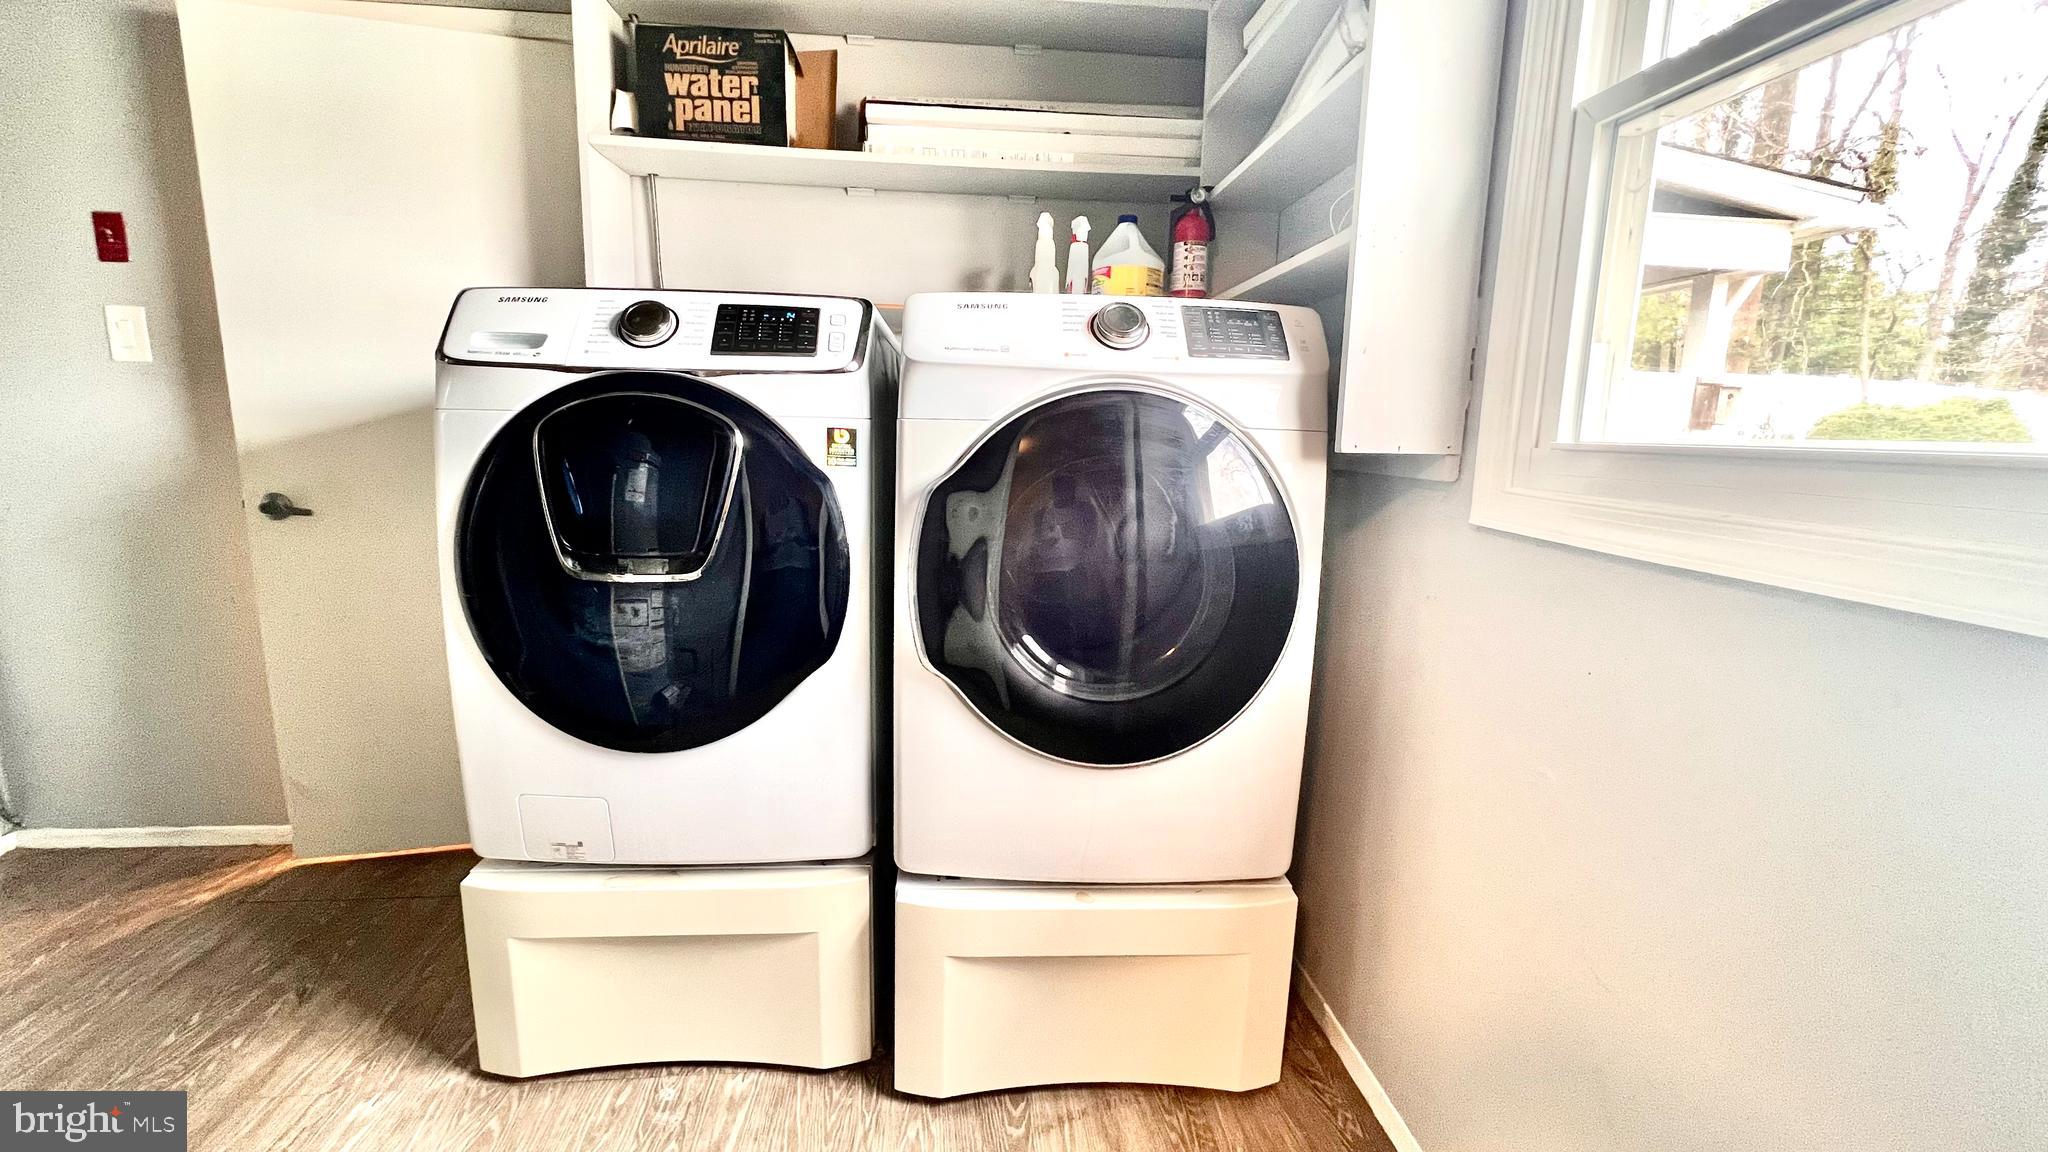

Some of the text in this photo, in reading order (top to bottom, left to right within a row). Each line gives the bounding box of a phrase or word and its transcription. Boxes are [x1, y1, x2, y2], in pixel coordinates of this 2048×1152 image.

[662, 32, 739, 60] Aprilaire
[664, 69, 759, 98] water
[675, 95, 760, 131] panel
